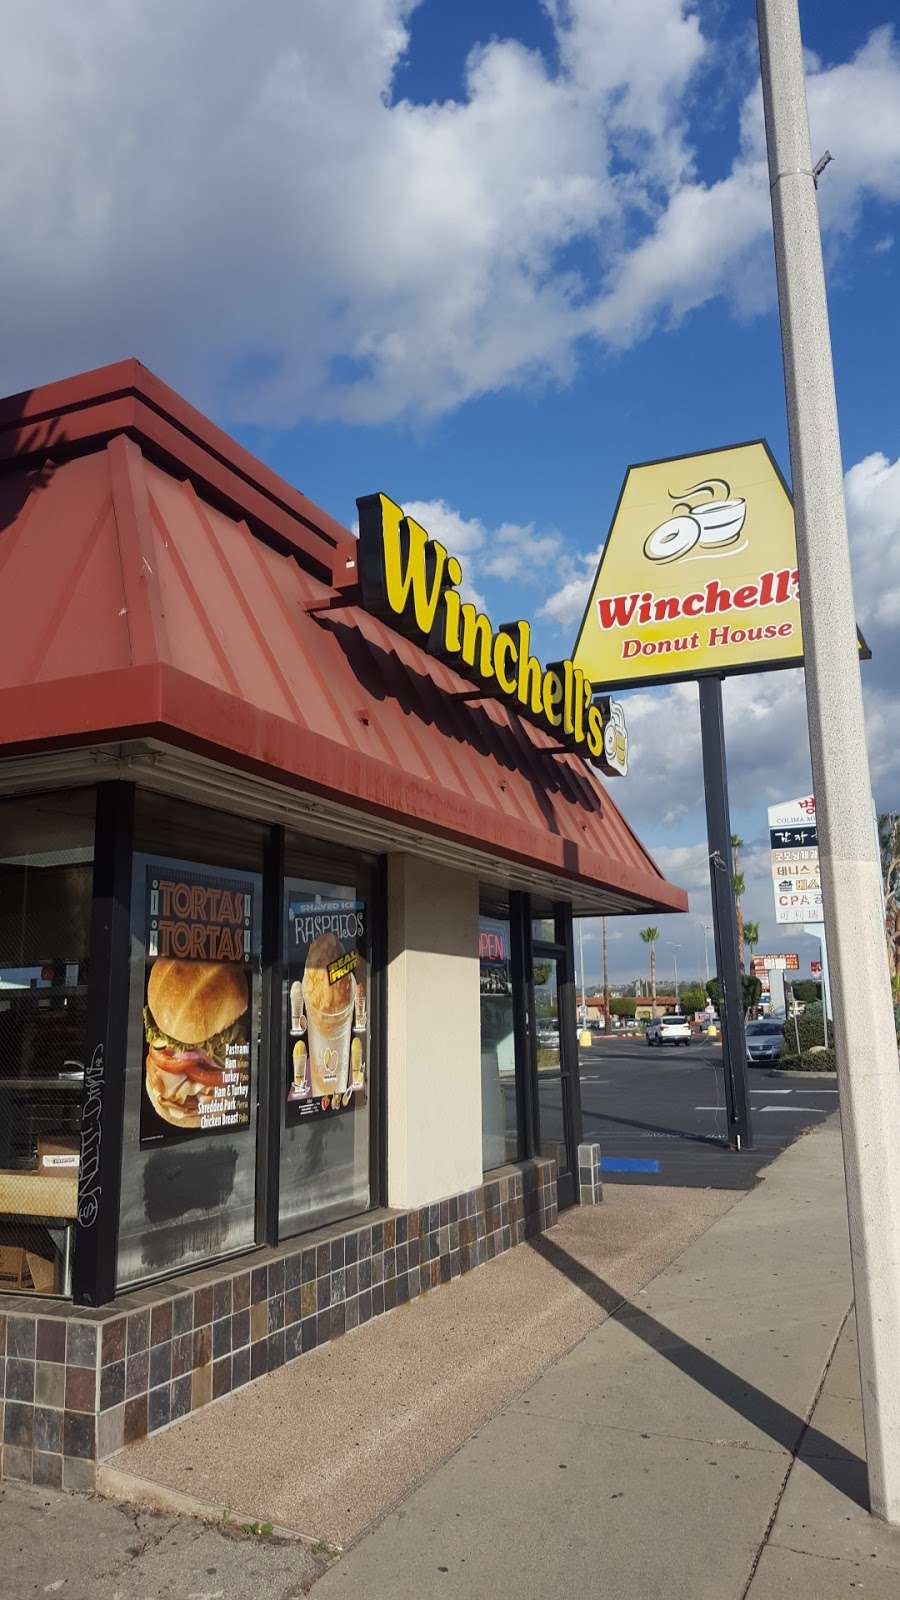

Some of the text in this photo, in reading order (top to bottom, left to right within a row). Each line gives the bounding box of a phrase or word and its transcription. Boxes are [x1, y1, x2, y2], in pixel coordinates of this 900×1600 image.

[598, 569, 800, 629] Winchell'
[379, 491, 605, 757] Winchell's
[621, 622, 793, 659] Donut House
[300, 901, 355, 911] SHAVED ICE
[779, 894, 810, 906] CPA
[478, 933, 505, 960] PEN
[331, 957, 358, 982] FRUIT
[225, 1042, 250, 1056] Pastrami
[224, 1057, 237, 1069] Ham
[222, 1069, 240, 1085] Turkey
[214, 1086, 226, 1098] Ham
[231, 1082, 249, 1098] Turkey
[197, 1099, 224, 1114] Shredded
[224, 1097, 237, 1111] Pork
[201, 1114, 222, 1128] Chicken
[222, 1112, 239, 1126] Breast
